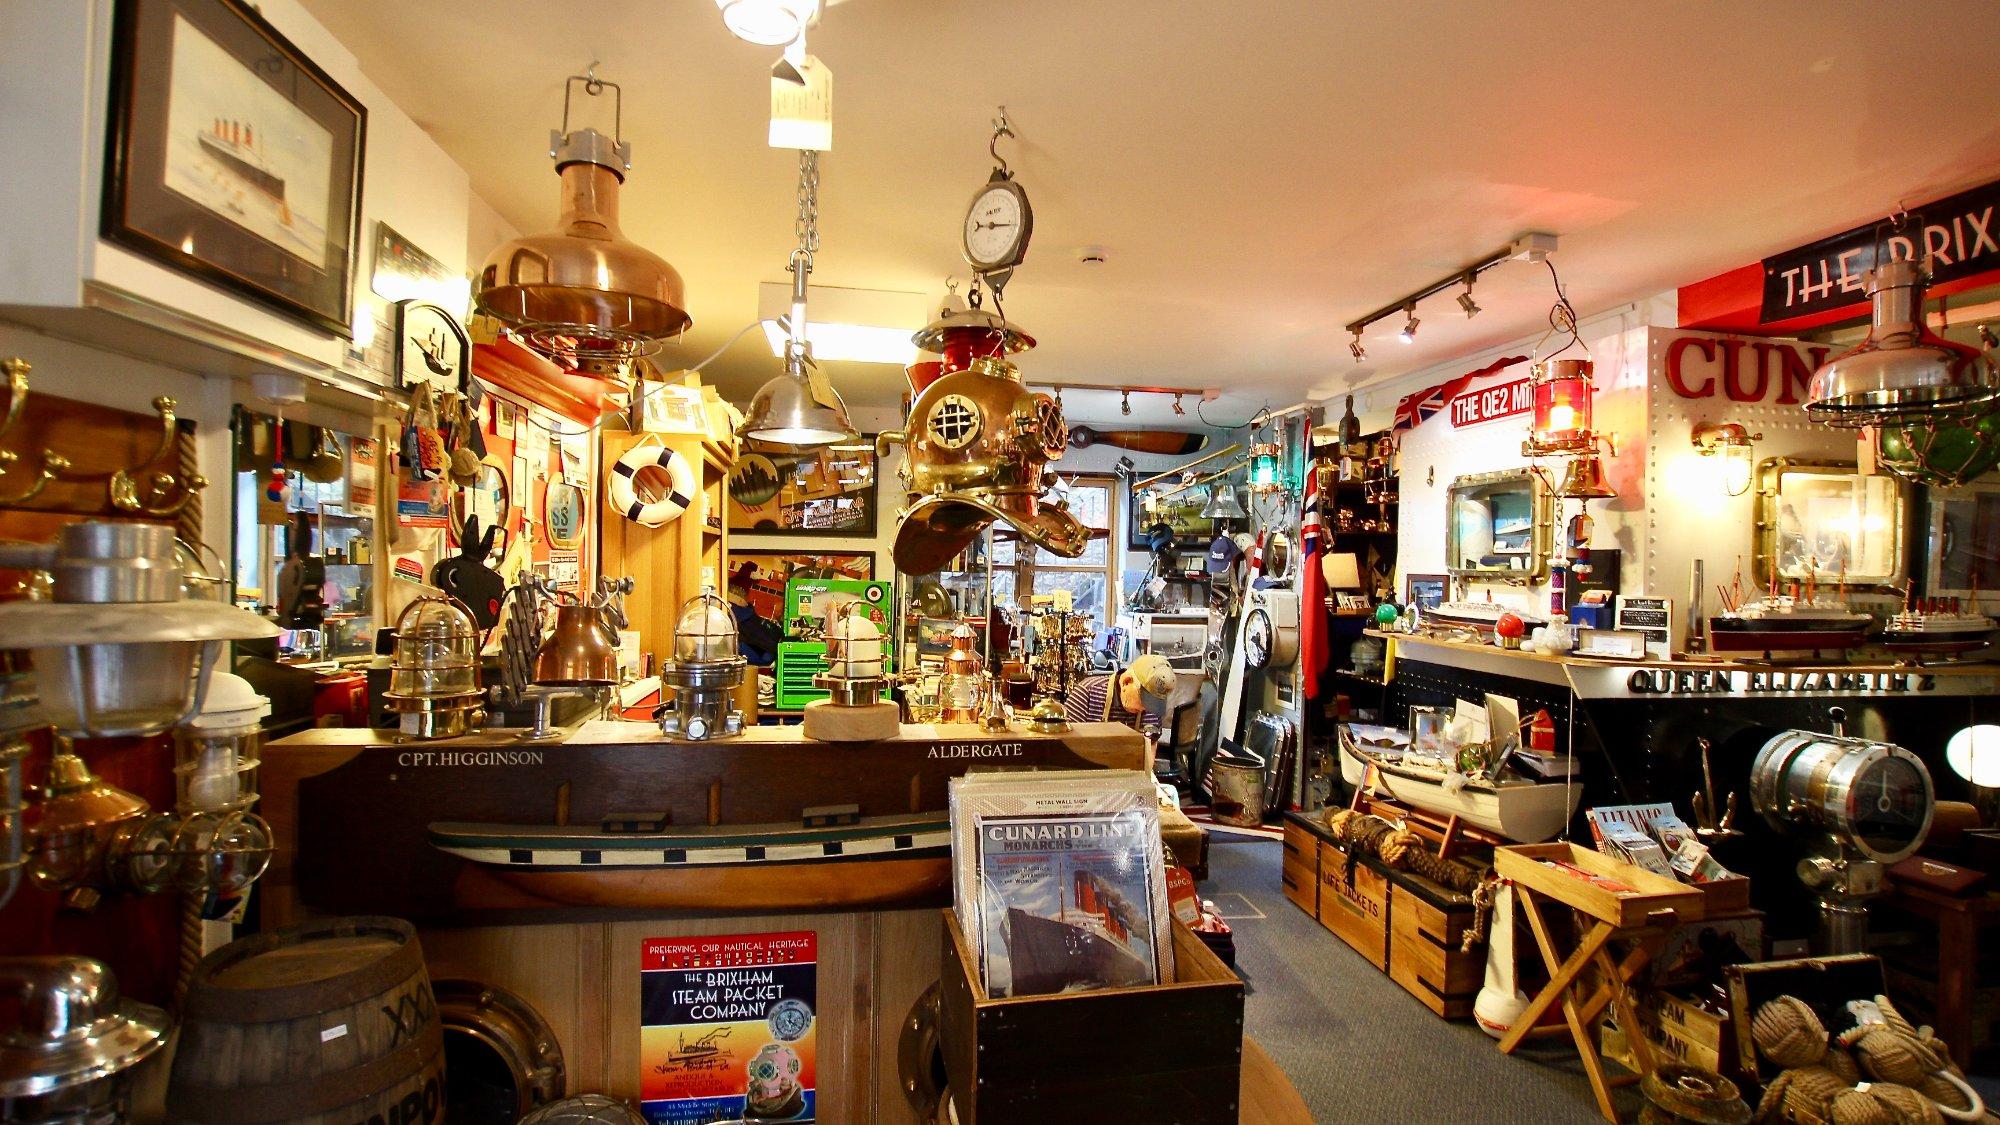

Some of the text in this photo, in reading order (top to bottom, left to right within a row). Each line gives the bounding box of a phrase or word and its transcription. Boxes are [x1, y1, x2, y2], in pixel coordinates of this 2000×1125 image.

[1781, 248, 1864, 307] THE
[1454, 395, 1479, 425] THE
[1482, 387, 1509, 418] QE2
[1627, 669, 1734, 694] QUEEN
[1745, 671, 1909, 693] ELIZABETH
[927, 743, 1024, 759] ALDERGATE
[988, 824, 1084, 842] CUNARD
[1003, 839, 1073, 852] MONARCHS
[1323, 870, 1379, 918] LIFE JACKETS
[701, 943, 720, 953] OUR
[724, 941, 764, 951] NAUTICAL
[768, 938, 809, 949] HERITAGE
[684, 970, 773, 987] THE BRIXHAM
[672, 984, 784, 1005] STEAM PACKET
[690, 1001, 766, 1020] COMPANY
